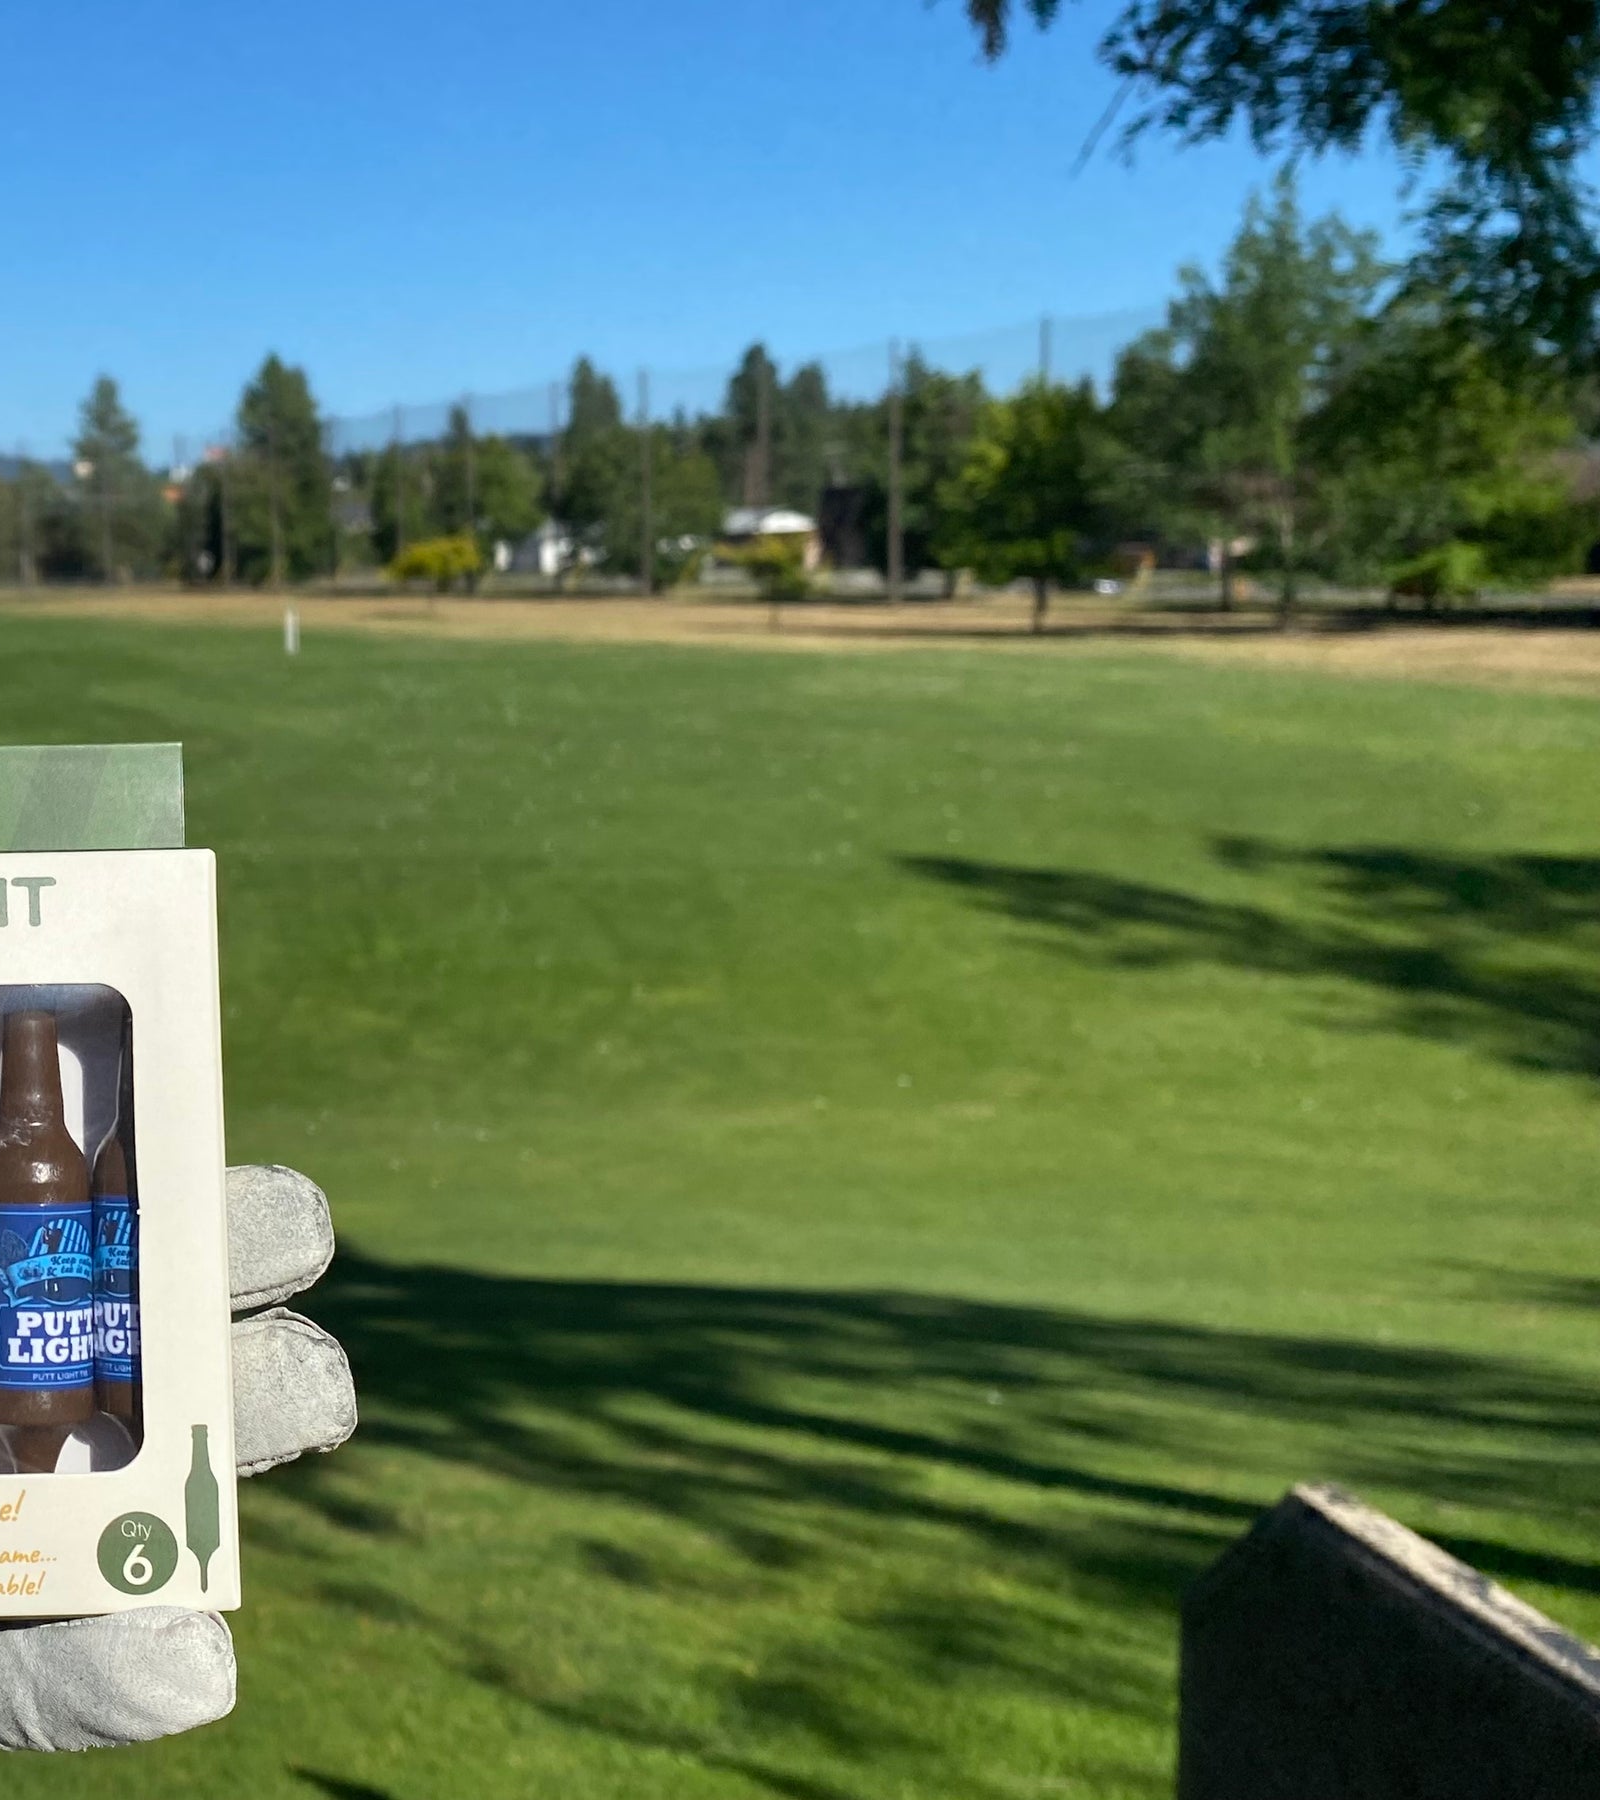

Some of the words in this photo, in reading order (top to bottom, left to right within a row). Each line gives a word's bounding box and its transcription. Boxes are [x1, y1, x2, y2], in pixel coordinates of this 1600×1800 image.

[94, 1301, 138, 1329] PUT
[121, 1520, 152, 1541] Qty
[122, 1543, 153, 1586] 6
